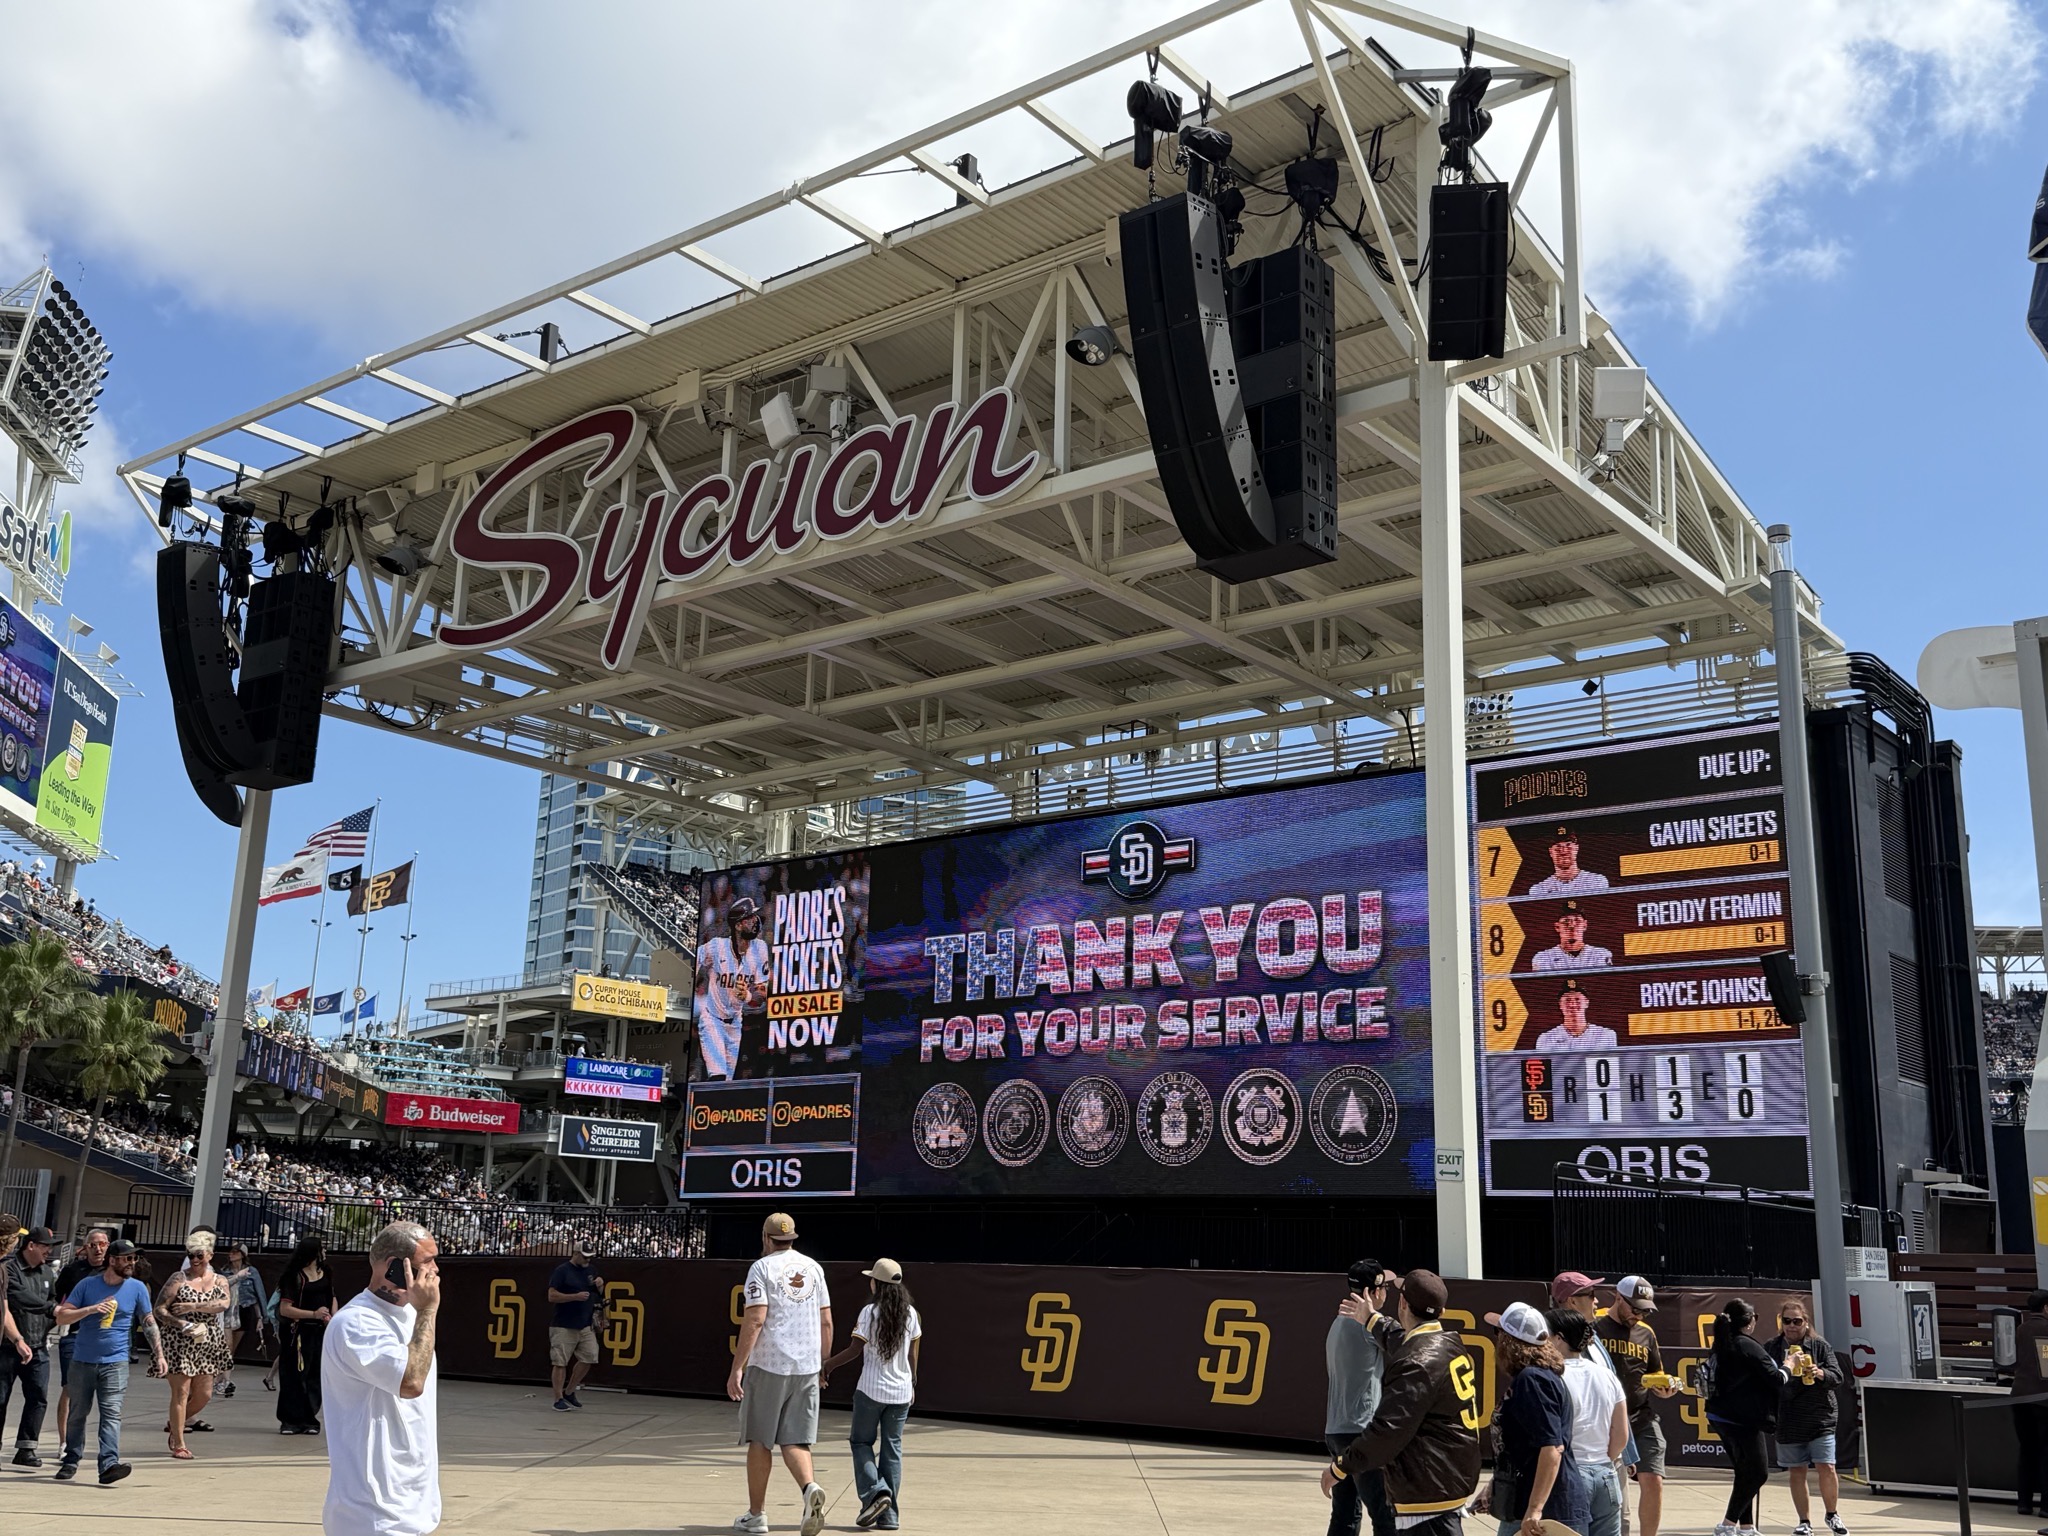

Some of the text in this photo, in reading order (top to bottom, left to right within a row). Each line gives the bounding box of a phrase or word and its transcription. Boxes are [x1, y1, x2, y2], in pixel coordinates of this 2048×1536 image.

[436, 386, 1047, 671] Sycuan
[11, 665, 42, 713] YOU
[1699, 748, 1771, 780] DUE UP:
[48, 772, 96, 818] Leading the Way
[1504, 769, 1588, 807] PADRES
[50, 801, 61, 818] San
[61, 806, 76, 828] Diego
[1650, 810, 1778, 847] GAVIN SHEETS
[1119, 832, 1154, 886] SD
[1487, 846, 1502, 878] 7
[1750, 844, 1771, 862] 0-1
[773, 885, 846, 945] PADRES
[1637, 891, 1782, 926] FREDDY FERMIN
[924, 889, 1383, 1004] THANK YOU
[1489, 924, 1504, 957] 8
[1755, 926, 1777, 943] 0-1
[771, 938, 844, 995] TICKETS
[594, 984, 641, 998] CURRY HOUSE
[594, 992, 663, 1011] CoCo ICHIBANYA
[771, 994, 840, 1018] ON SALE
[1640, 980, 1698, 1008] BRYCE
[154, 998, 187, 1041] PADRES
[919, 986, 1390, 1063] FOR YOUR SERVICE
[1492, 1000, 1507, 1031] 9
[1736, 1010, 1760, 1030] 1-1,
[767, 1015, 839, 1050] NOW
[589, 1062, 629, 1078] LANDCARE
[630, 1067, 655, 1078] LOGIC
[1595, 1059, 1610, 1088] 0
[1668, 1056, 1678, 1086] 1
[1738, 1054, 1748, 1084] 1
[652, 1088, 658, 1100] 8
[1563, 1072, 1716, 1103] R H E
[429, 1104, 506, 1126] Budweiser
[710, 1106, 767, 1125] @PADRES
[790, 1104, 852, 1121] @PADRES
[1599, 1092, 1609, 1121] 1
[1668, 1090, 1683, 1120] 3
[1738, 1088, 1754, 1118] 0
[590, 1135, 640, 1148] SCHREIBER
[591, 1124, 641, 1138] SINGLETON
[731, 1158, 802, 1188] ORIS
[1436, 1153, 1463, 1167] EXIT
[1576, 1143, 1711, 1183] ORIS
[1864, 1250, 1873, 1260] SAN
[787, 1295, 805, 1304] DIEGO
[488, 1279, 526, 1359] SD
[603, 1281, 645, 1367] SD
[1021, 1291, 1082, 1393] SD
[1198, 1299, 1271, 1406] SD
[1601, 1338, 1649, 1364] PADRES
[1682, 1443, 1715, 1455] petco
